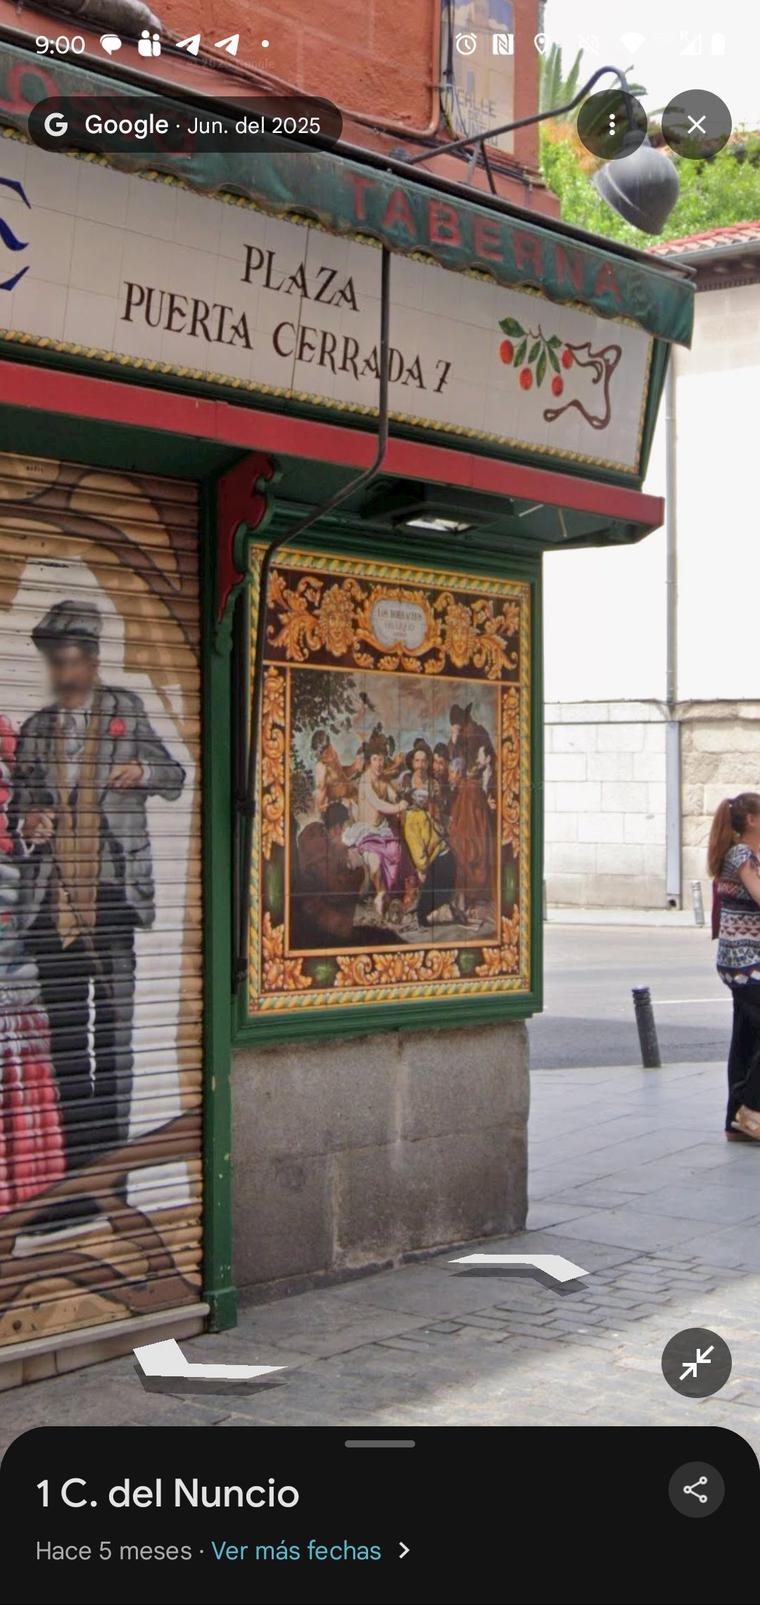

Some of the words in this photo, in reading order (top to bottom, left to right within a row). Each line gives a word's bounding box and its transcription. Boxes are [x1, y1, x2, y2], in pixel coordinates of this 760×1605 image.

[241, 244, 360, 312] PLAZA
[346, 172, 625, 302] TABERNA
[120, 281, 253, 350] PUERTA
[272, 321, 427, 393] CERRADA
[433, 360, 452, 394] 7
